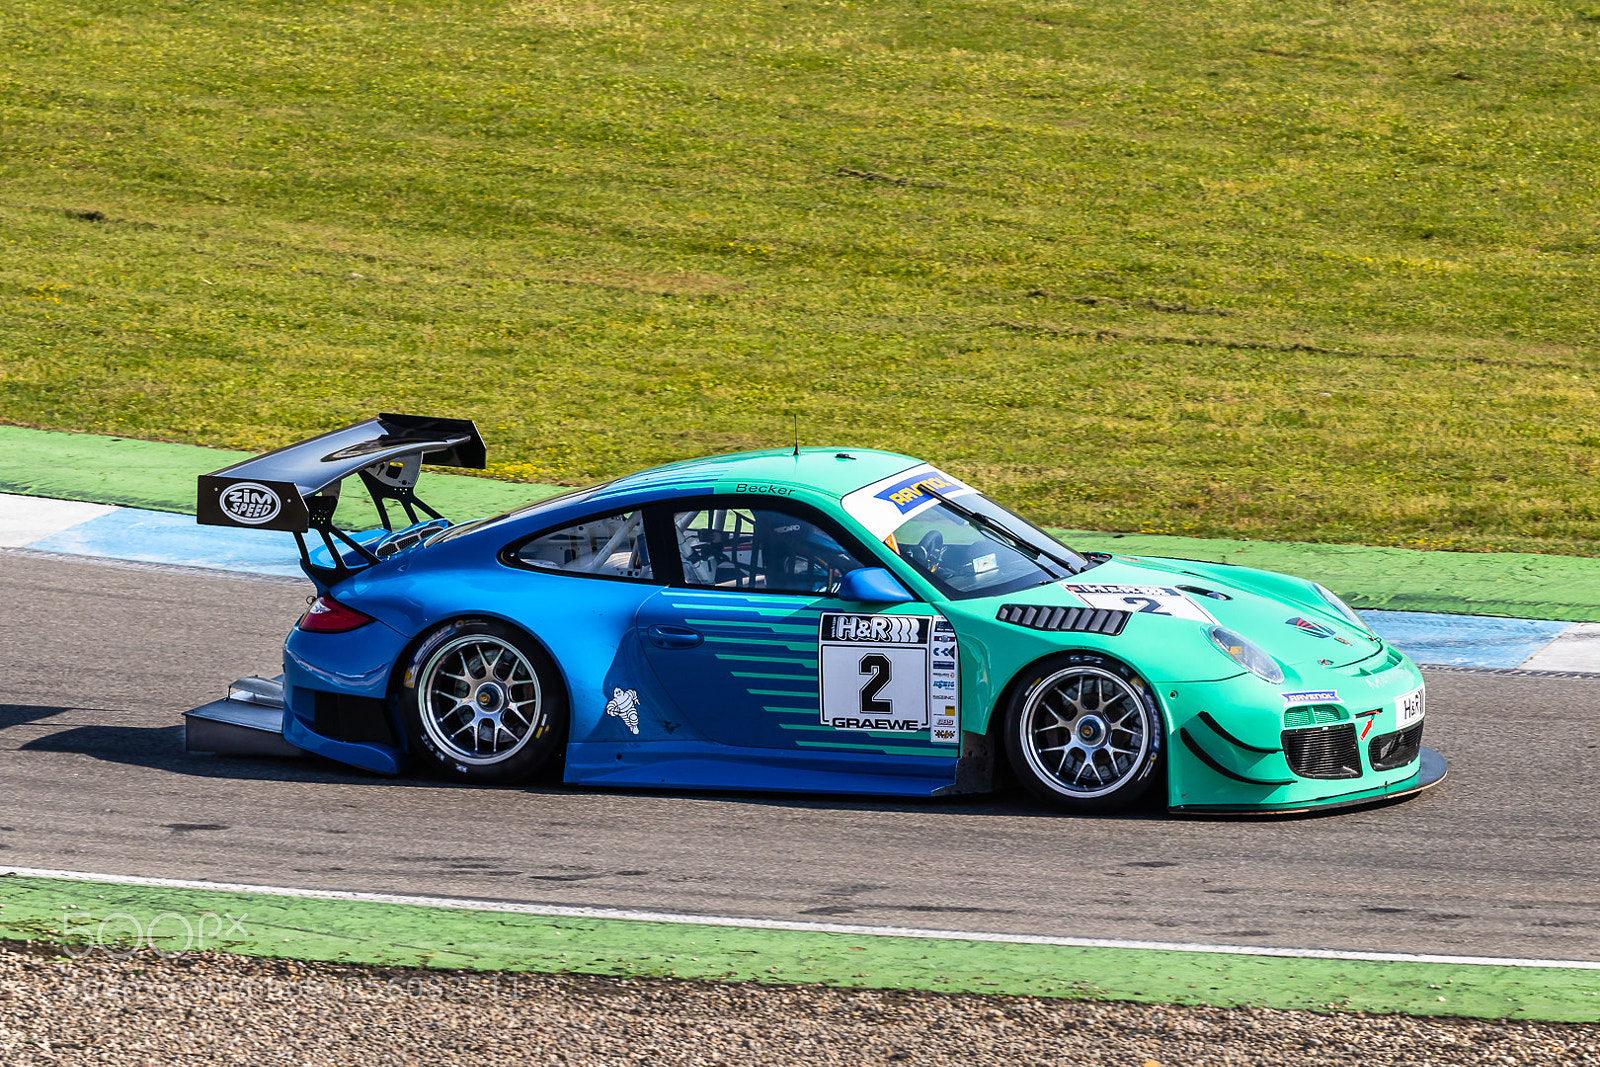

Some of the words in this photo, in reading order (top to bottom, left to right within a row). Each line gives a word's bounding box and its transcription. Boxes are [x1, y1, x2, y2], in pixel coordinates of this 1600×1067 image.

[736, 483, 796, 496] Becker
[230, 503, 271, 517] SPEED
[1122, 596, 1173, 616] 2
[837, 616, 892, 642] H&R
[859, 653, 893, 714] 2
[1288, 691, 1334, 702] RAVENOL
[832, 717, 919, 731] GRAEWE
